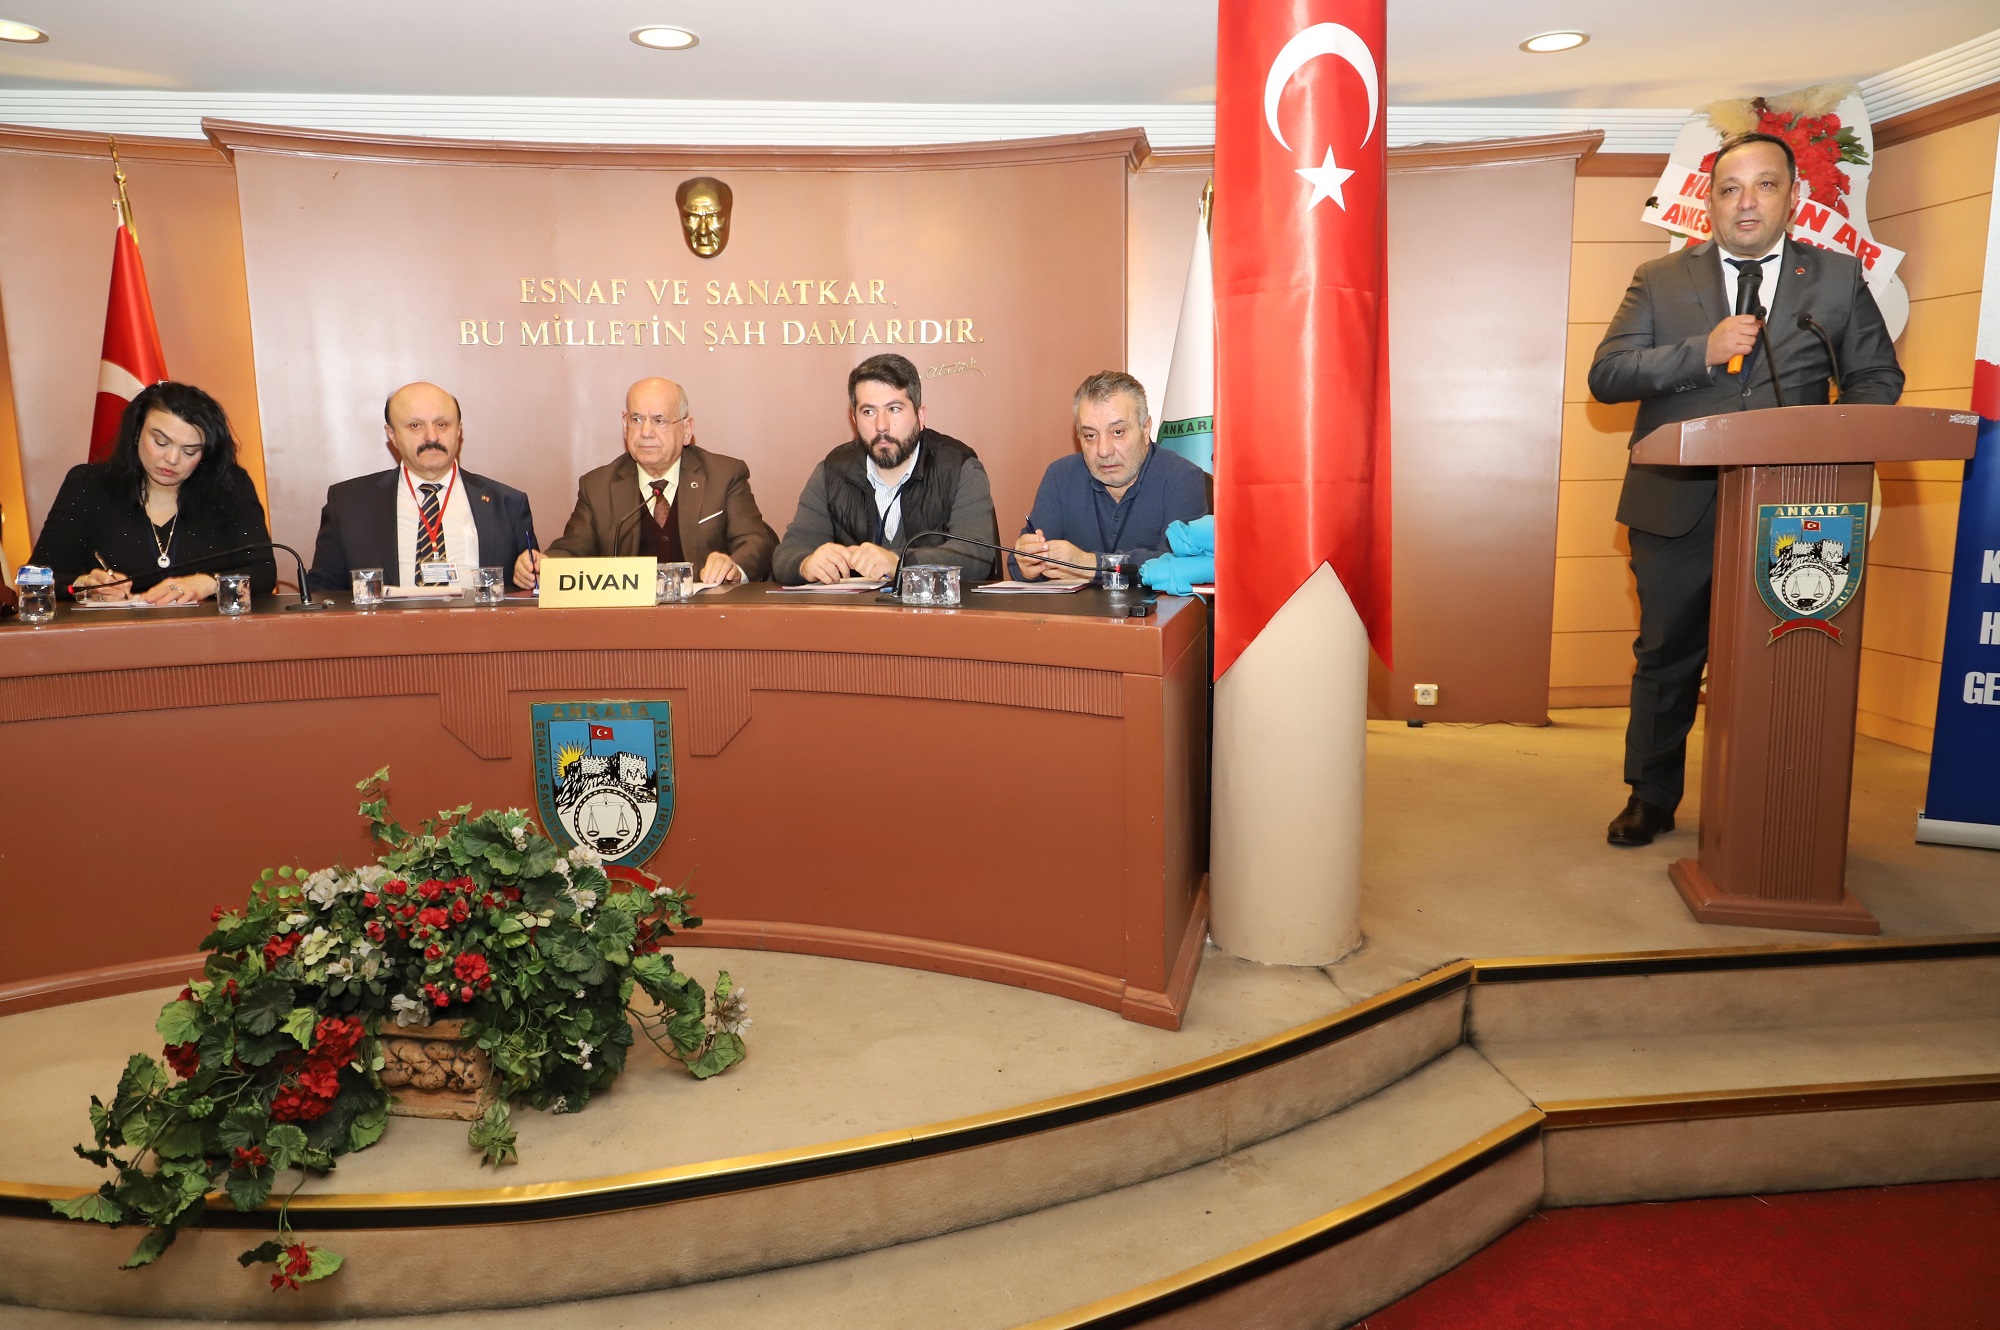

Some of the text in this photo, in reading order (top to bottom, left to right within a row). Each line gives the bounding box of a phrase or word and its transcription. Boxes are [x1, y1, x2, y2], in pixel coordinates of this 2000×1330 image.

[1832, 222, 1882, 271] AR
[518, 278, 898, 308] ESNAF VE SANATKAR,
[458, 314, 985, 352] BU MİLLETİN ŞAH DAMARIDIR.
[1163, 420, 1214, 435] ANKAR
[1774, 505, 1851, 517] ANKARA
[559, 570, 640, 592] DİVAN
[1980, 549, 2000, 584] K
[1979, 611, 2000, 645] H
[1962, 671, 2000, 706] GE
[552, 704, 650, 719] ANKARA
[535, 720, 547, 765] ESNAF
[631, 806, 670, 863] ODALARI
